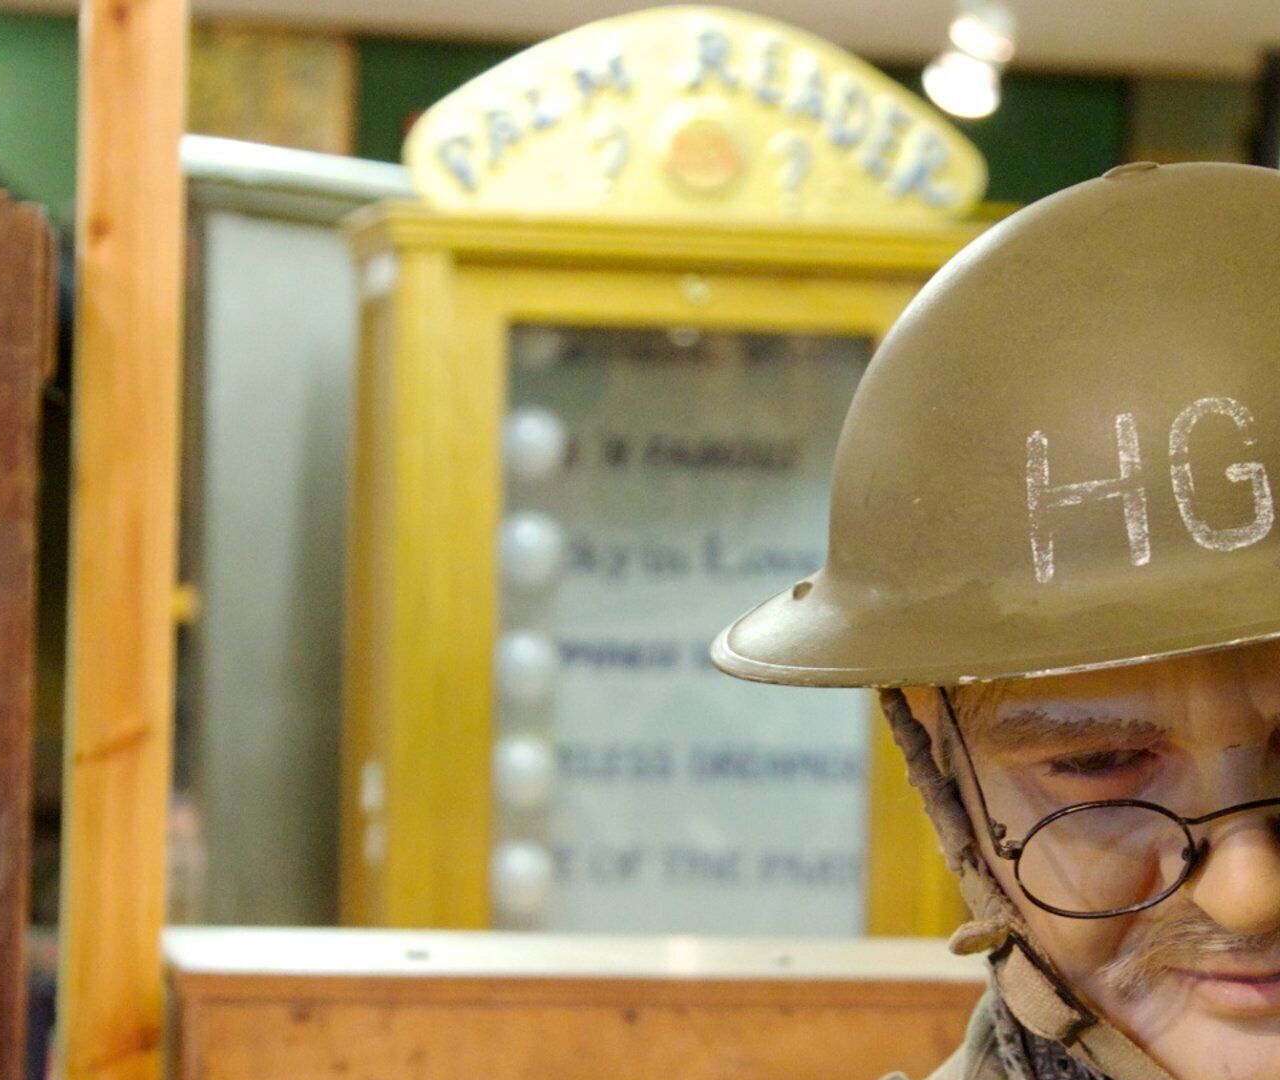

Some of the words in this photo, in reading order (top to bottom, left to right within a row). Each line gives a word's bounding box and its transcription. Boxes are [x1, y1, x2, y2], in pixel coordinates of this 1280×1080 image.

[439, 56, 631, 193] PALM
[683, 28, 961, 209] READER
[1026, 396, 1274, 583] HG
